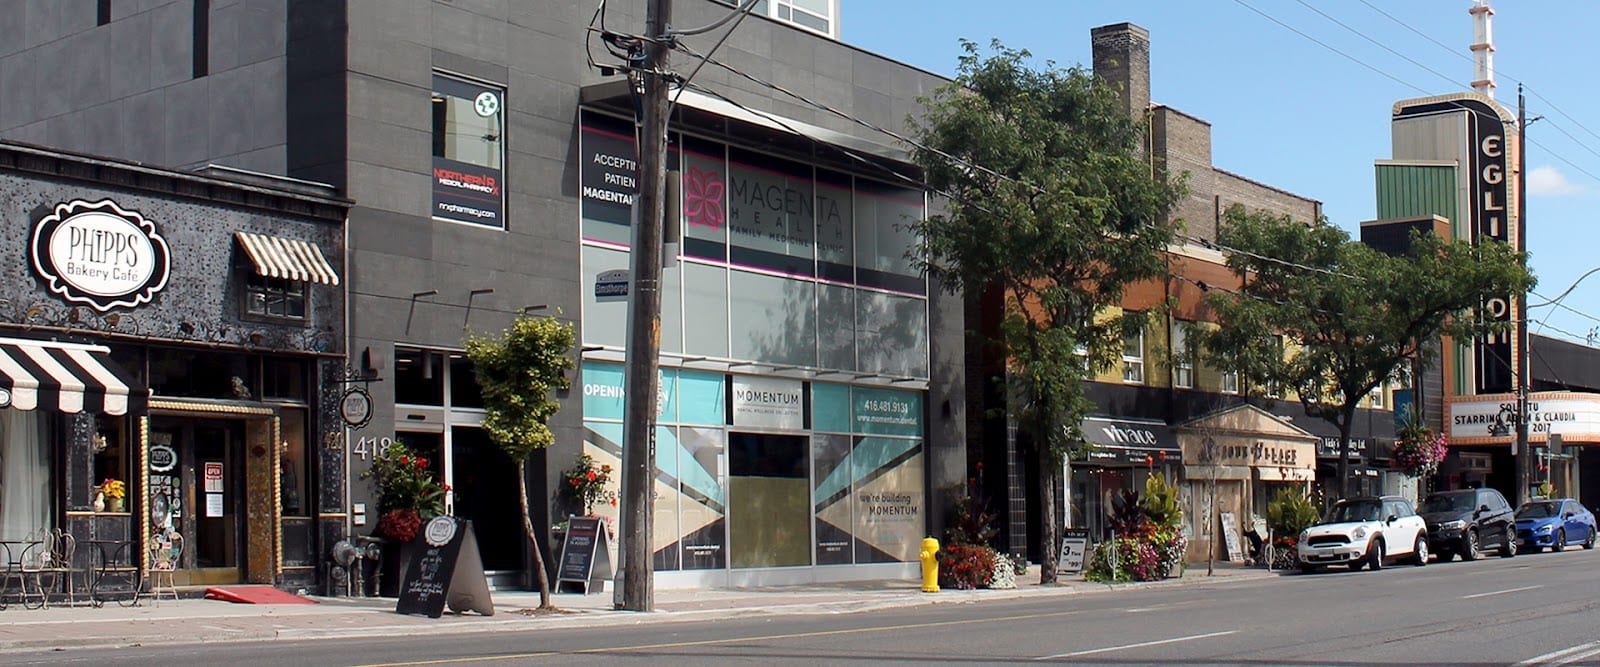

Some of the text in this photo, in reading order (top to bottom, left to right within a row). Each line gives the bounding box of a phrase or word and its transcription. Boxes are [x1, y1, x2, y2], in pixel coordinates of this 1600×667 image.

[604, 172, 636, 188] PATIEN
[730, 176, 843, 224] MAGENTA
[730, 207, 843, 240] HEALTH
[66, 261, 139, 282] Bakery Café
[583, 383, 626, 399] OPENIN
[736, 390, 799, 405] MOMENTUM
[1535, 412, 1540, 421] &
[1544, 411, 1576, 421] CLAUDIA
[1533, 423, 1552, 432] 2017
[353, 436, 391, 462] 418
[881, 492, 911, 505] building
[869, 505, 918, 516] MOMENTUM
[1063, 545, 1071, 556] 3
